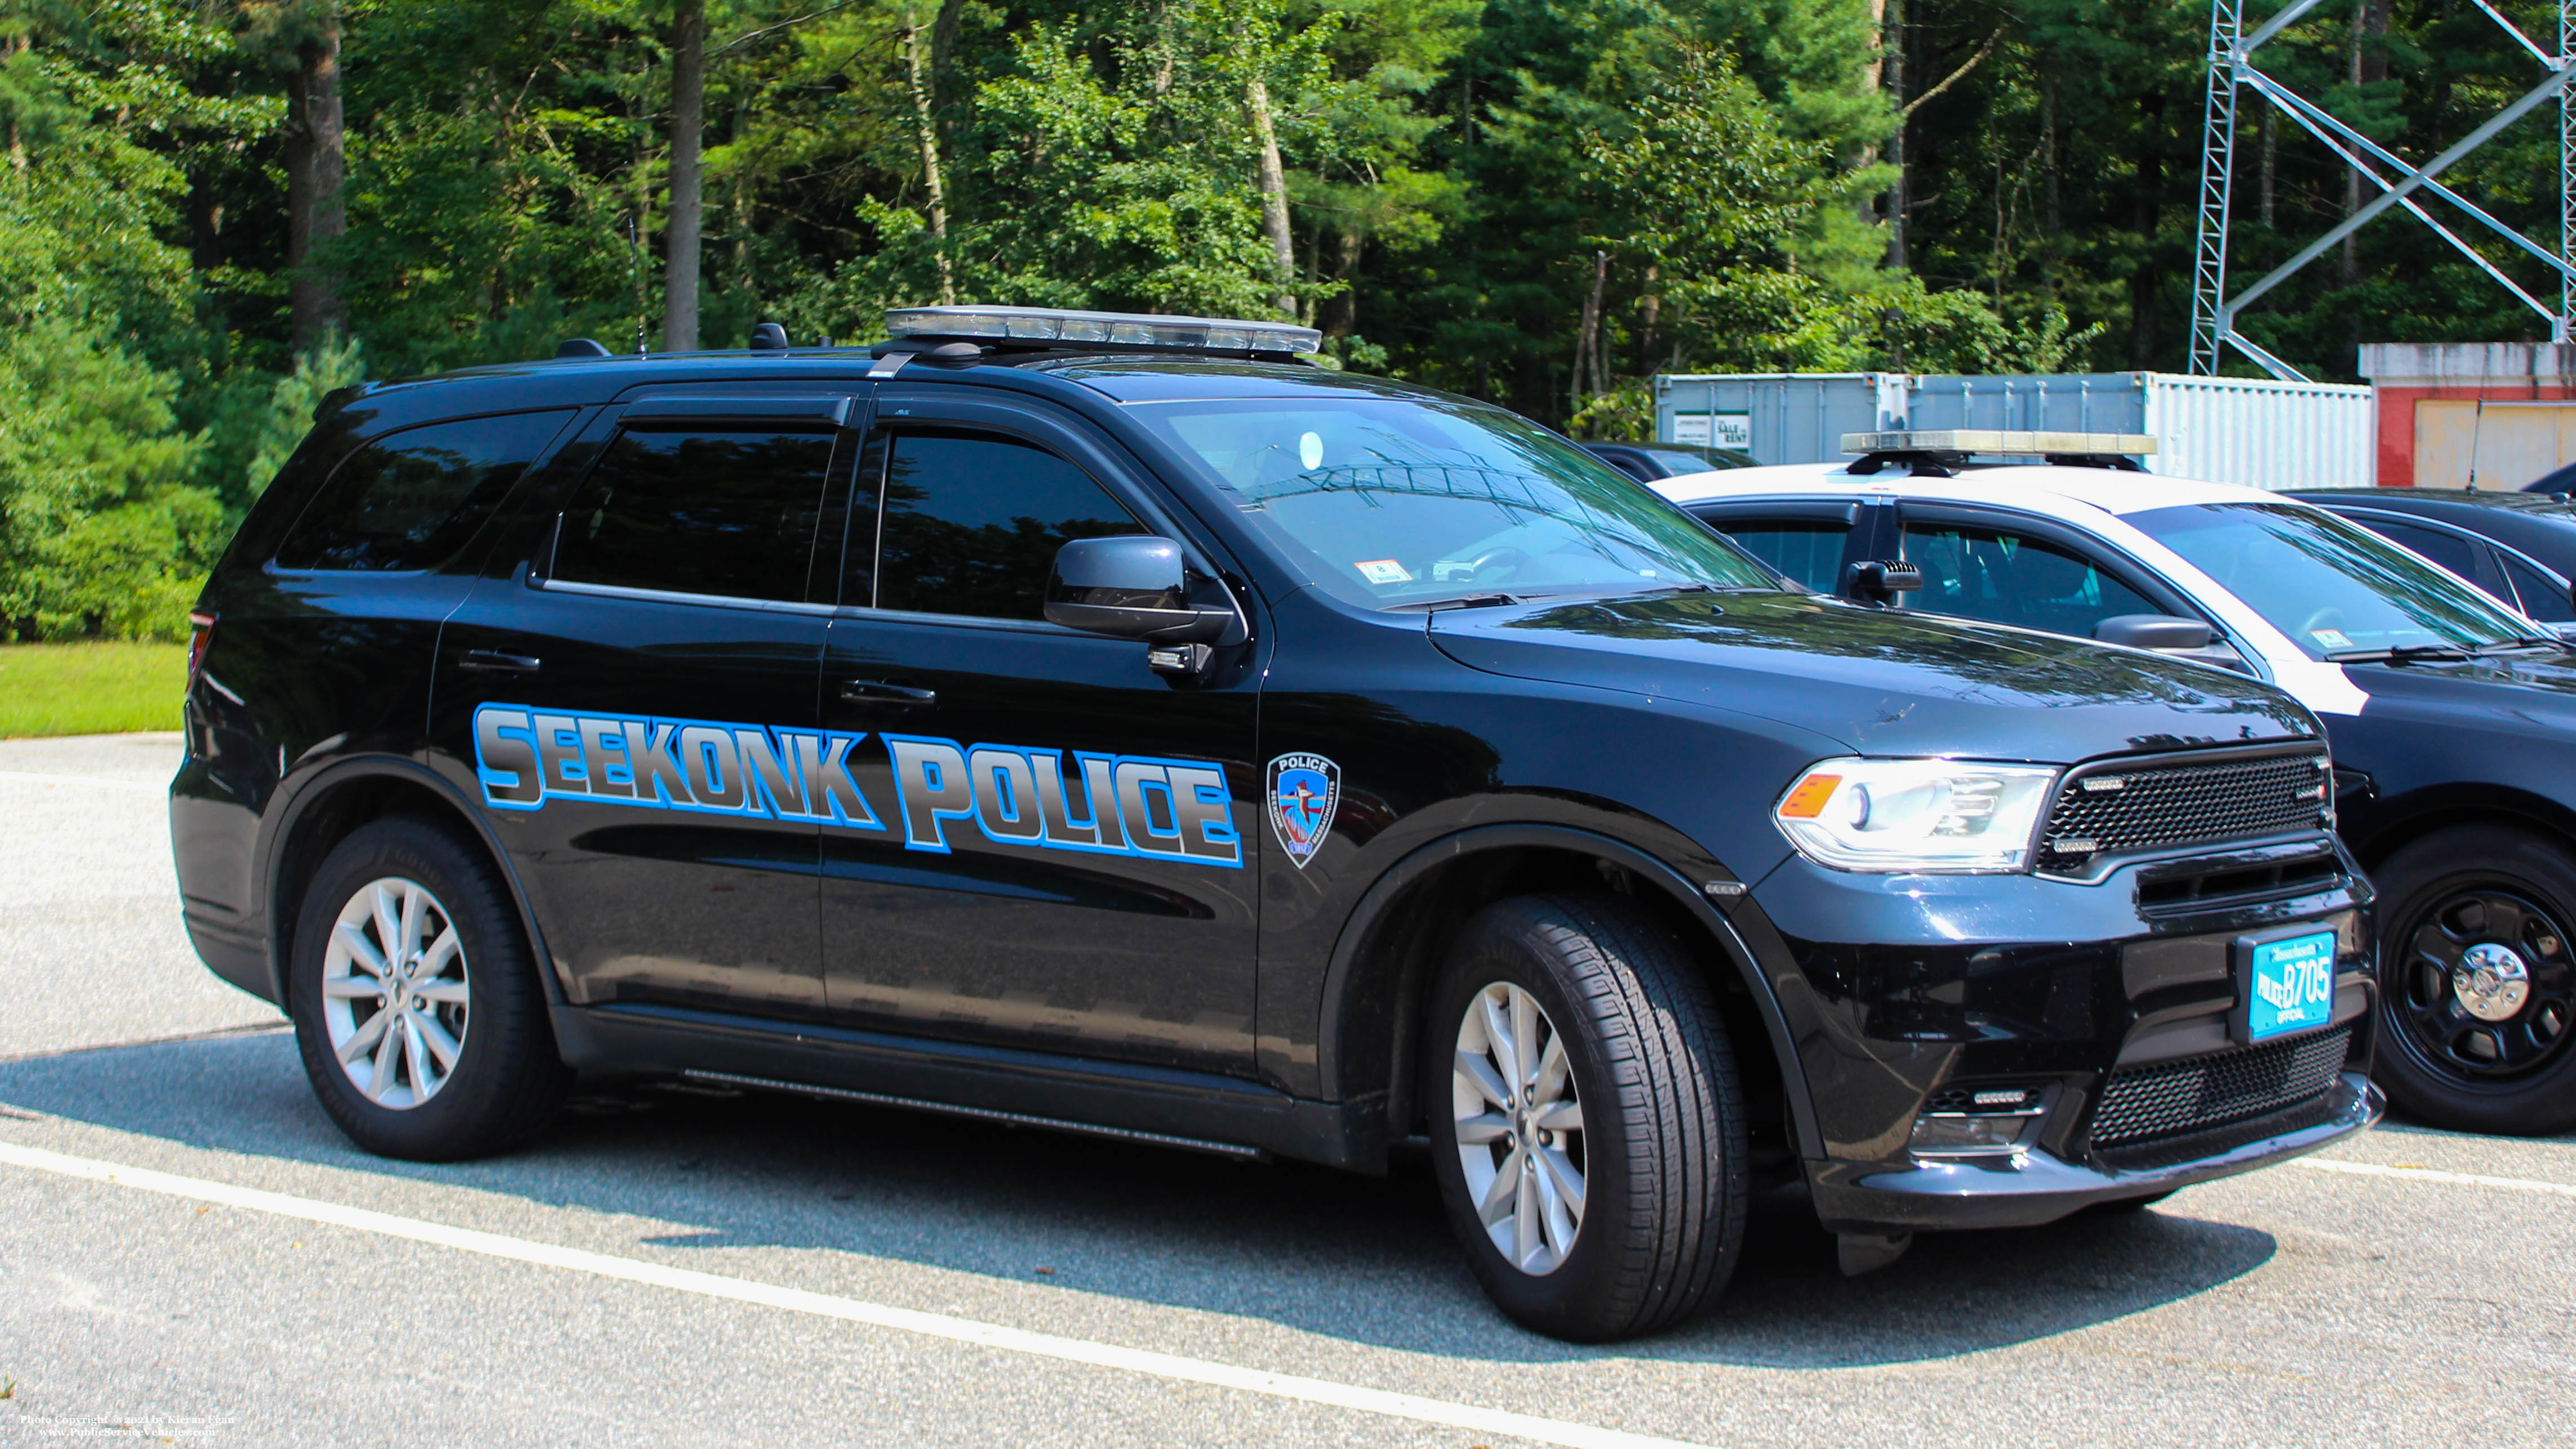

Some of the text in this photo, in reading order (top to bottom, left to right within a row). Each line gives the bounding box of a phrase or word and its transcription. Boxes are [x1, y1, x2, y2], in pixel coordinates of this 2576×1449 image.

[1717, 424, 1738, 433] SALE
[1726, 433, 1746, 442] RENT
[473, 702, 1243, 868] SEEKONK POLICE
[1278, 757, 1329, 774] POLICE
[1271, 790, 1284, 830] SEEKONK
[1312, 781, 1335, 844] MASSACHUSETTS
[2282, 956, 2330, 1009] B705
